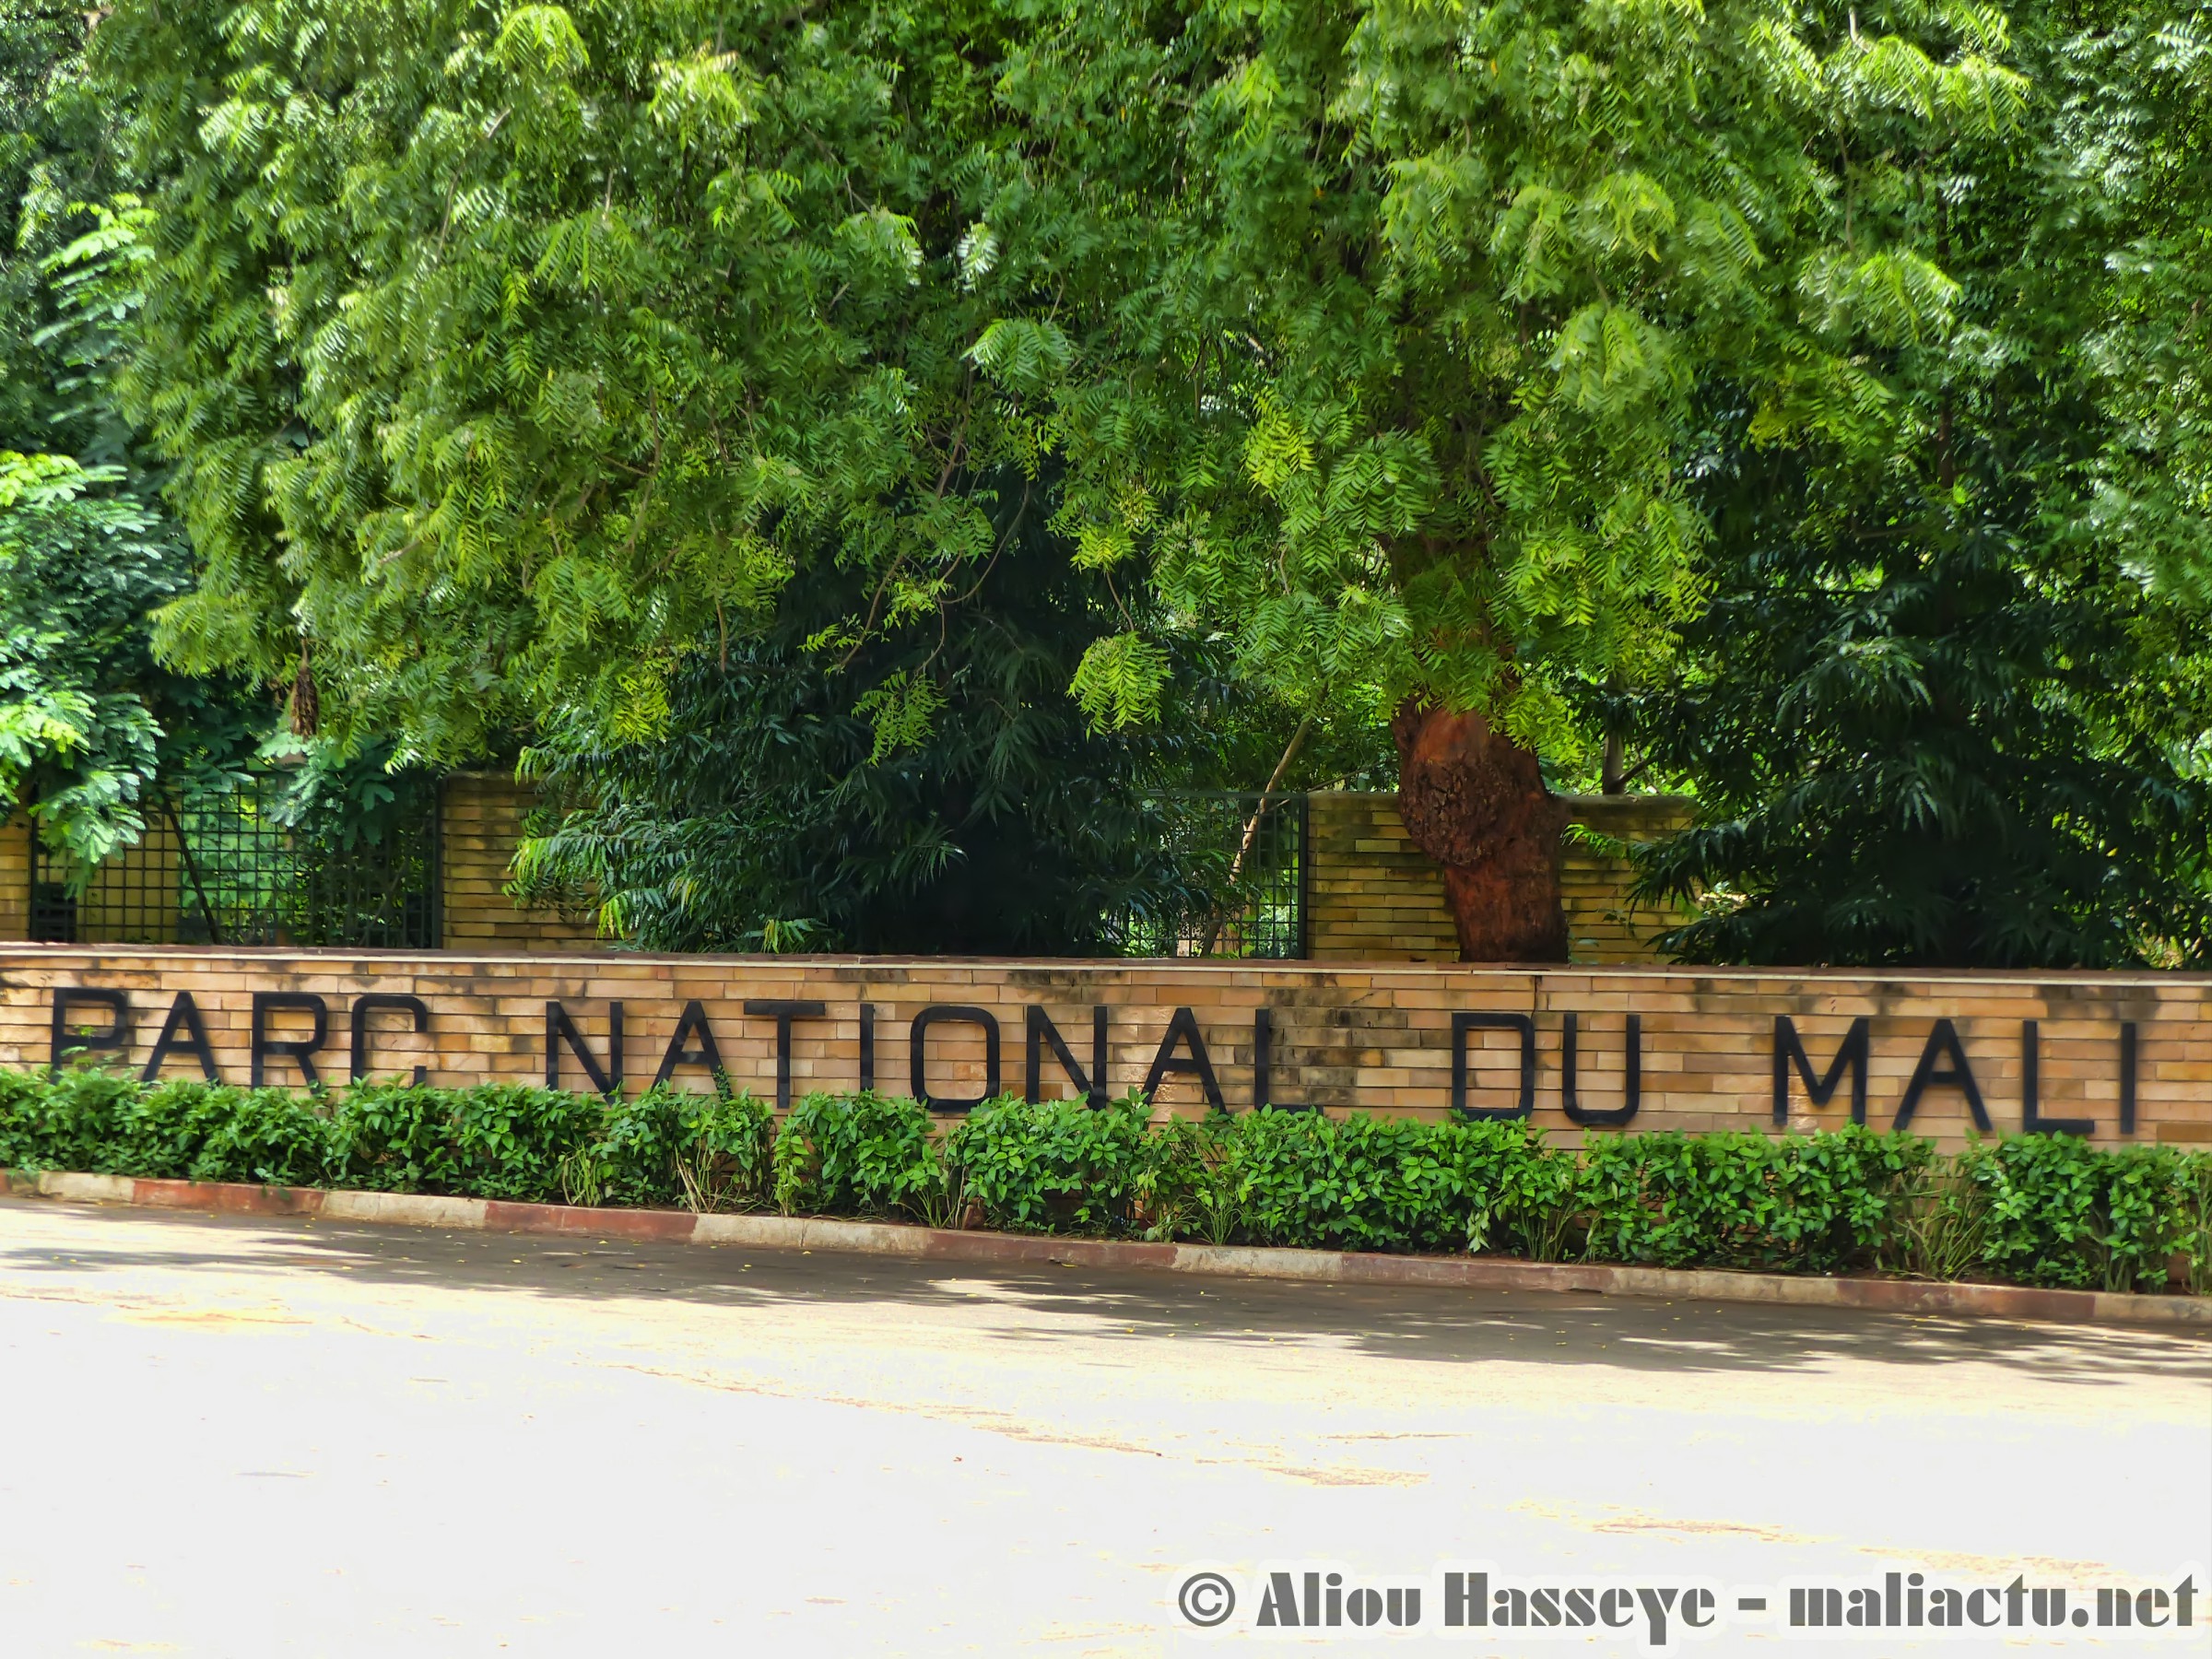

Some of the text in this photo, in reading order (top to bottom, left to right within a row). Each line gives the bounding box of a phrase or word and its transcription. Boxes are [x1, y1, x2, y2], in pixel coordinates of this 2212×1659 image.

[51, 986, 2136, 1135] PARC NATIONAL DU MALI
